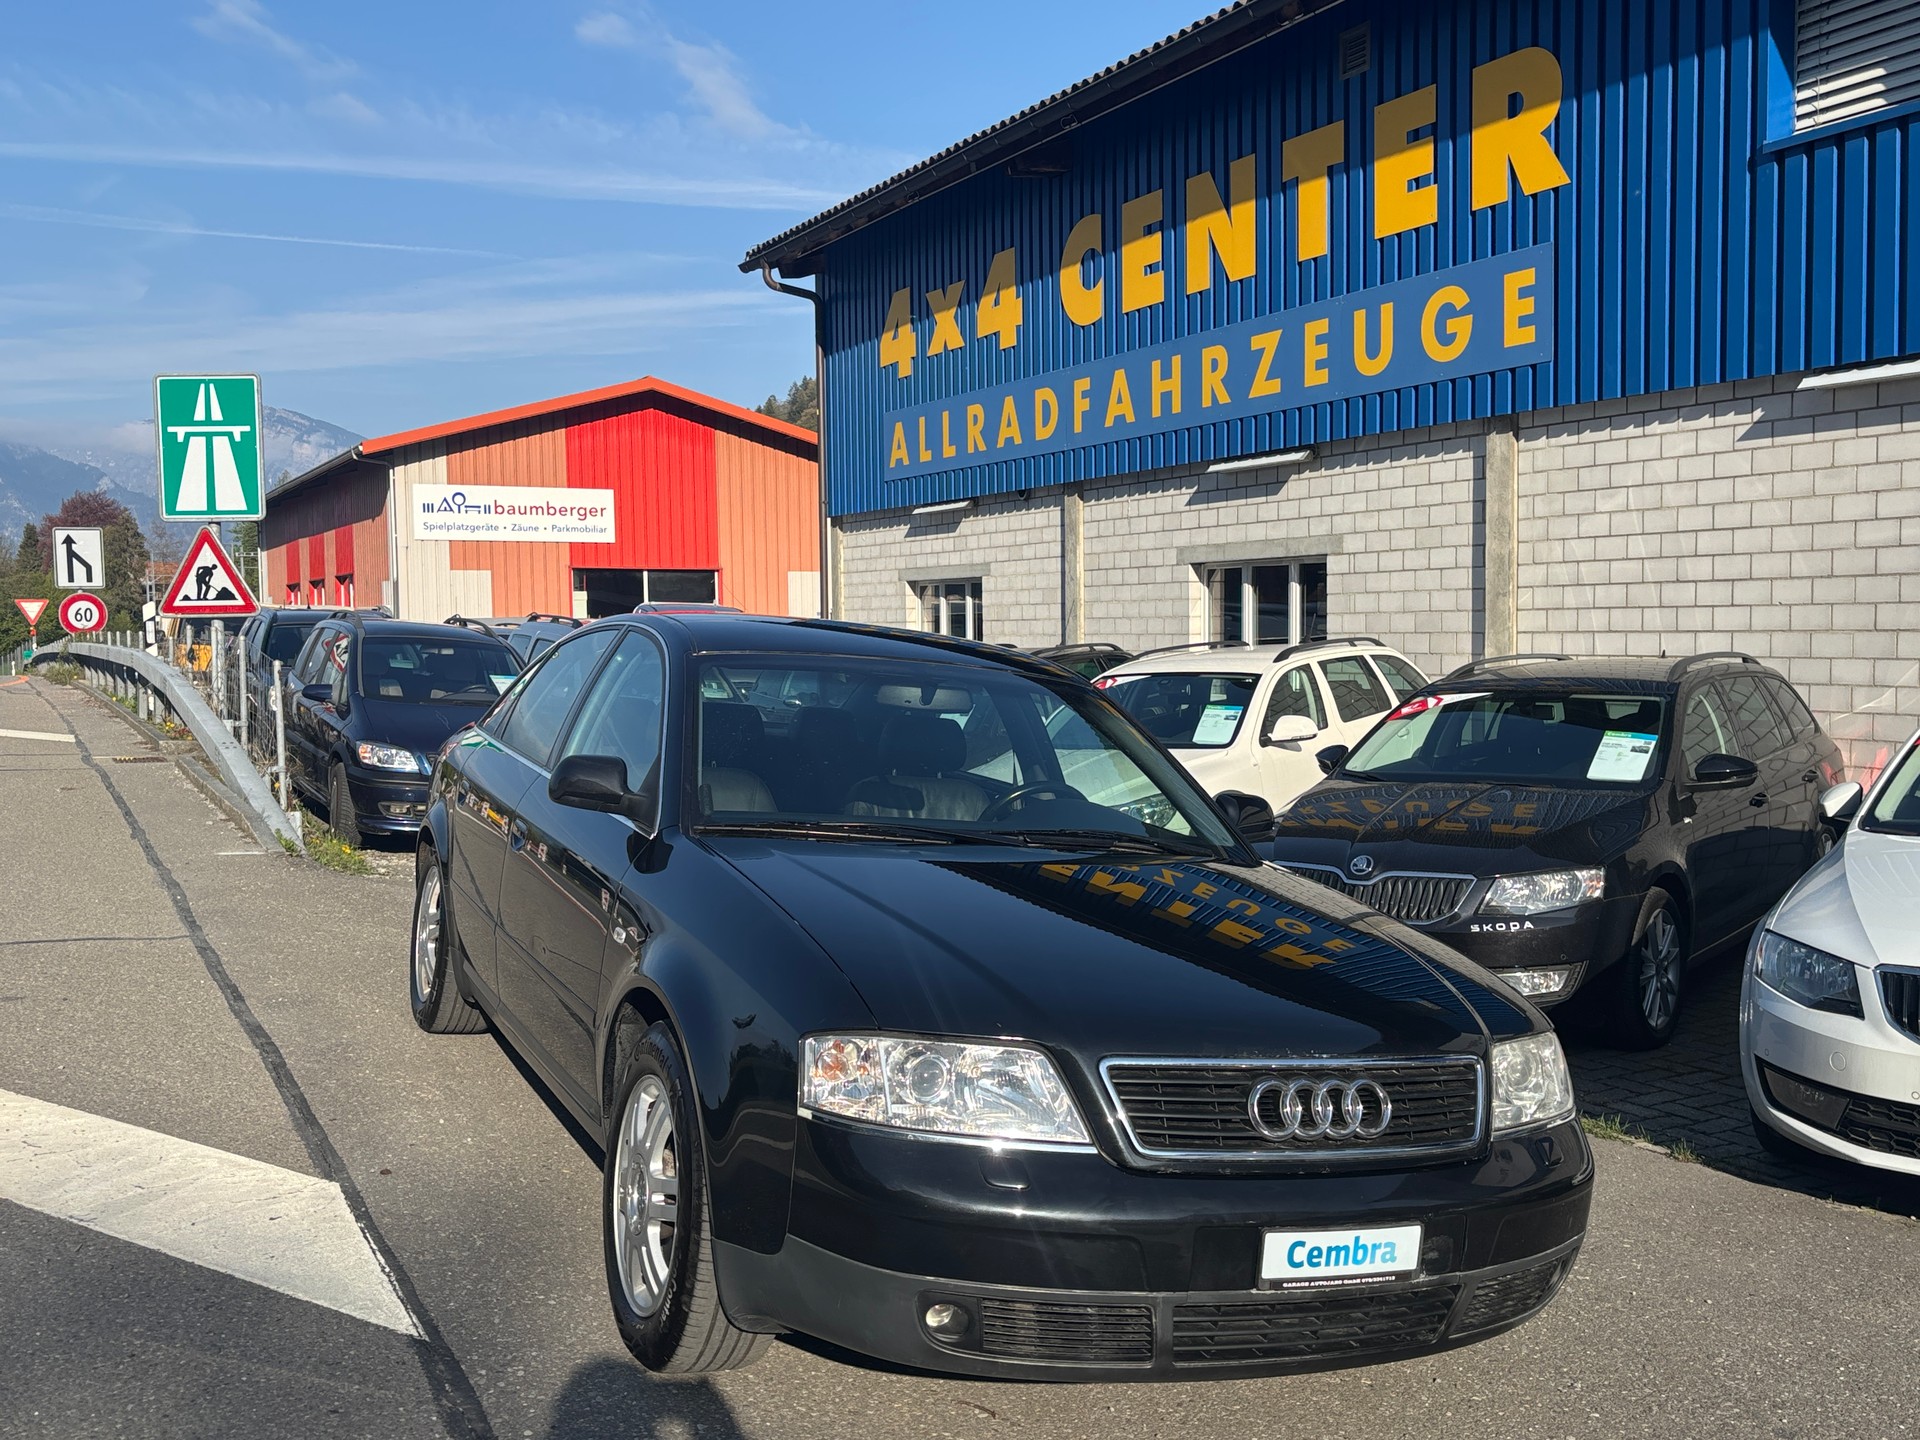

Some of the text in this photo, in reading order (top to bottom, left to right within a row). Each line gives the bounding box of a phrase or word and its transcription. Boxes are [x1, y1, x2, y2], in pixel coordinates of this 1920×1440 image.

[879, 47, 1571, 379] 4x4 CENTER
[889, 267, 1537, 469] ALLRADFAHRZEUGE
[494, 499, 607, 521] baumberger
[423, 522, 608, 534] Spielplatzgeräte Zäune Parkmobiliar
[74, 607, 93, 622] 60
[1286, 1236, 1398, 1269] Cembra
